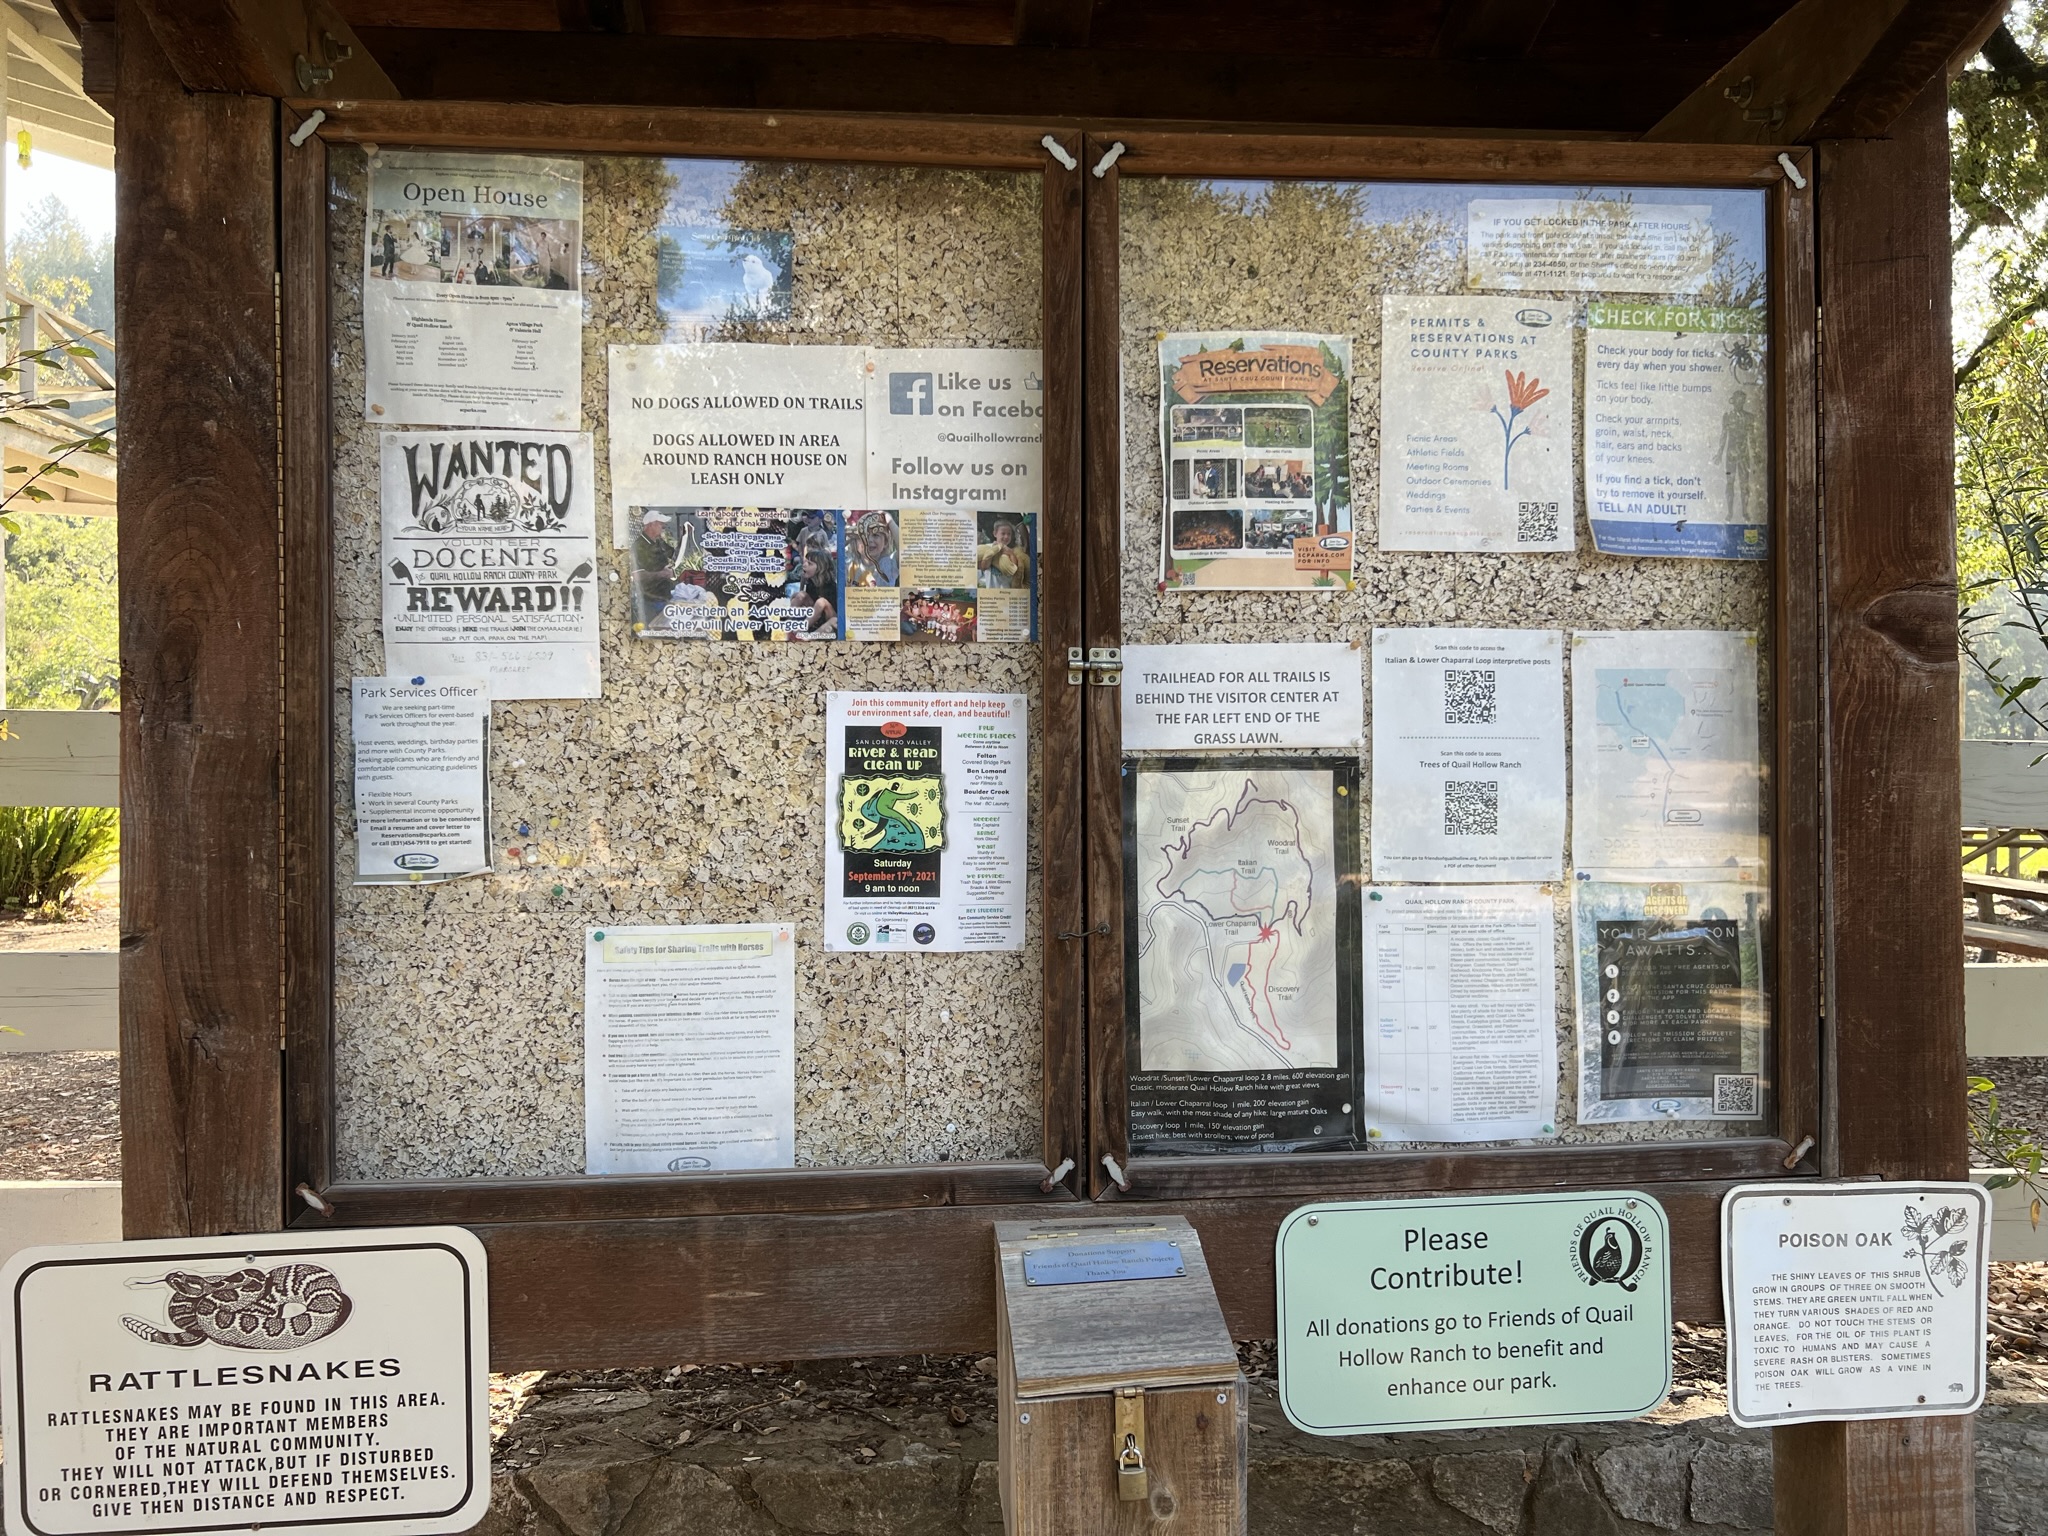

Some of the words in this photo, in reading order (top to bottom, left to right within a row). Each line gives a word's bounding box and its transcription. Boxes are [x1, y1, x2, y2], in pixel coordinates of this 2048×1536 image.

[403, 183, 465, 206] Open
[473, 185, 548, 208] House
[1411, 319, 1471, 327] PERMITS
[1479, 319, 1485, 327] &
[1596, 309, 1655, 325] CHECK
[1664, 312, 1700, 327] FOR
[1411, 334, 1514, 344] RESERVATIONS
[1521, 336, 1537, 345] AT
[1411, 349, 1468, 358] COUNTY
[1476, 350, 1518, 359] PARKS
[1200, 355, 1321, 378] Reservations
[938, 372, 981, 390] Like
[989, 378, 1011, 390] us
[632, 398, 653, 409] NO
[658, 397, 699, 409] DOGS
[703, 397, 779, 408] ALLOWED
[783, 397, 805, 408] ON
[809, 398, 863, 410] TRAILS
[938, 405, 964, 417] on
[653, 434, 694, 446] DOGS
[698, 434, 775, 446] ALLOWED
[779, 435, 795, 446] IN
[799, 435, 840, 447] AREA
[643, 453, 709, 466] AROUND
[714, 453, 766, 466] RANCH
[771, 454, 821, 466] HOUSE
[826, 454, 847, 466] ON
[892, 456, 964, 475] Follow
[971, 463, 994, 475] us
[1001, 464, 1027, 476] on
[402, 440, 573, 519] WANTED
[691, 473, 739, 485] LEASH
[744, 473, 785, 485] ONLY
[892, 483, 1006, 505] Instagram!
[1597, 502, 1624, 513] TELL
[1627, 502, 1642, 513] AN
[1646, 503, 1686, 515] ADULT!
[412, 548, 558, 568] DOCENTS
[407, 586, 583, 612] REWARD!!
[665, 606, 692, 616] Give
[694, 607, 726, 616] them
[750, 606, 813, 616] Adventure
[398, 615, 452, 623] UNLIMITED
[456, 615, 507, 623] PERSONAL
[671, 621, 699, 630] they
[702, 620, 721, 630] will
[725, 621, 762, 631] Never
[765, 620, 808, 631] Forget!
[1143, 673, 1215, 683] TRAILHEAD
[1219, 672, 1244, 683] FOR
[1248, 672, 1270, 683] ALL
[1273, 671, 1316, 682] TRAILS
[1320, 672, 1330, 682] IS
[360, 688, 386, 698] Park
[390, 688, 436, 698] Services
[440, 687, 478, 697] Officer
[1136, 693, 1184, 704] BEHIND
[1188, 693, 1212, 703] THE
[1216, 692, 1267, 703] VISITOR
[1270, 692, 1319, 703] CENTER
[1323, 692, 1339, 702] AT
[852, 699, 869, 707] Join
[871, 699, 884, 707] this
[886, 699, 928, 709] community
[930, 699, 952, 708] effort
[954, 700, 968, 708] and
[970, 700, 986, 710] help
[988, 700, 1006, 709] keep
[862, 709, 911, 717] environment
[913, 709, 931, 718] safe,
[933, 709, 955, 718] clean,
[958, 709, 971, 718] and
[974, 709, 1010, 718] beautiful!
[1156, 714, 1180, 724] THE
[1185, 713, 1209, 724] FAR
[1213, 713, 1240, 723] LEFT
[1245, 713, 1271, 723] END
[1275, 712, 1291, 722] OF
[1296, 712, 1319, 722] THE
[1194, 733, 1236, 744] GRASS
[1240, 733, 1282, 743] LAWN.
[1452, 761, 1471, 769] Quail
[874, 859, 911, 868] Saturday
[848, 871, 895, 882] September
[865, 884, 870, 892] 9
[898, 885, 920, 893] noon
[639, 946, 654, 954] Tips
[656, 946, 666, 954] for
[668, 945, 696, 954] Sharing
[698, 945, 719, 953] Trails
[738, 943, 763, 951] Horses
[1268, 986, 1300, 994] Discovery
[1404, 1229, 1488, 1252] Please
[1779, 1234, 1848, 1247] POISON
[1856, 1233, 1892, 1246] OAK
[1370, 1260, 1523, 1290] Contribute!
[1306, 1319, 1330, 1337] All
[1336, 1317, 1429, 1335] donations
[1435, 1317, 1456, 1334] go
[1463, 1315, 1482, 1329] to
[1489, 1309, 1555, 1328] Friends
[1562, 1307, 1580, 1324] of
[1586, 1305, 1633, 1324] Quail
[1339, 1349, 1403, 1367] Hollow
[1410, 1345, 1466, 1363] Ranch
[1472, 1345, 1491, 1360] to
[1498, 1339, 1563, 1359] benefit
[1569, 1337, 1603, 1355] and
[90, 1358, 402, 1392] RATTLESNAKES
[1387, 1377, 1466, 1396] enhance
[1473, 1378, 1504, 1392] our
[1511, 1372, 1556, 1394] park.
[48, 1407, 179, 1426] RATTLESNAKES
[188, 1404, 223, 1420] MAY
[231, 1403, 252, 1417] BE
[261, 1400, 316, 1415] FOUND
[325, 1399, 341, 1411] IN
[350, 1395, 388, 1410] THIS
[397, 1392, 446, 1407] AREA.
[93, 1503, 132, 1518] GIVE
[141, 1500, 184, 1515] THEN
[194, 1494, 276, 1512] DISTANCE
[284, 1491, 316, 1506] AND
[326, 1487, 405, 1504] RESPECT.
